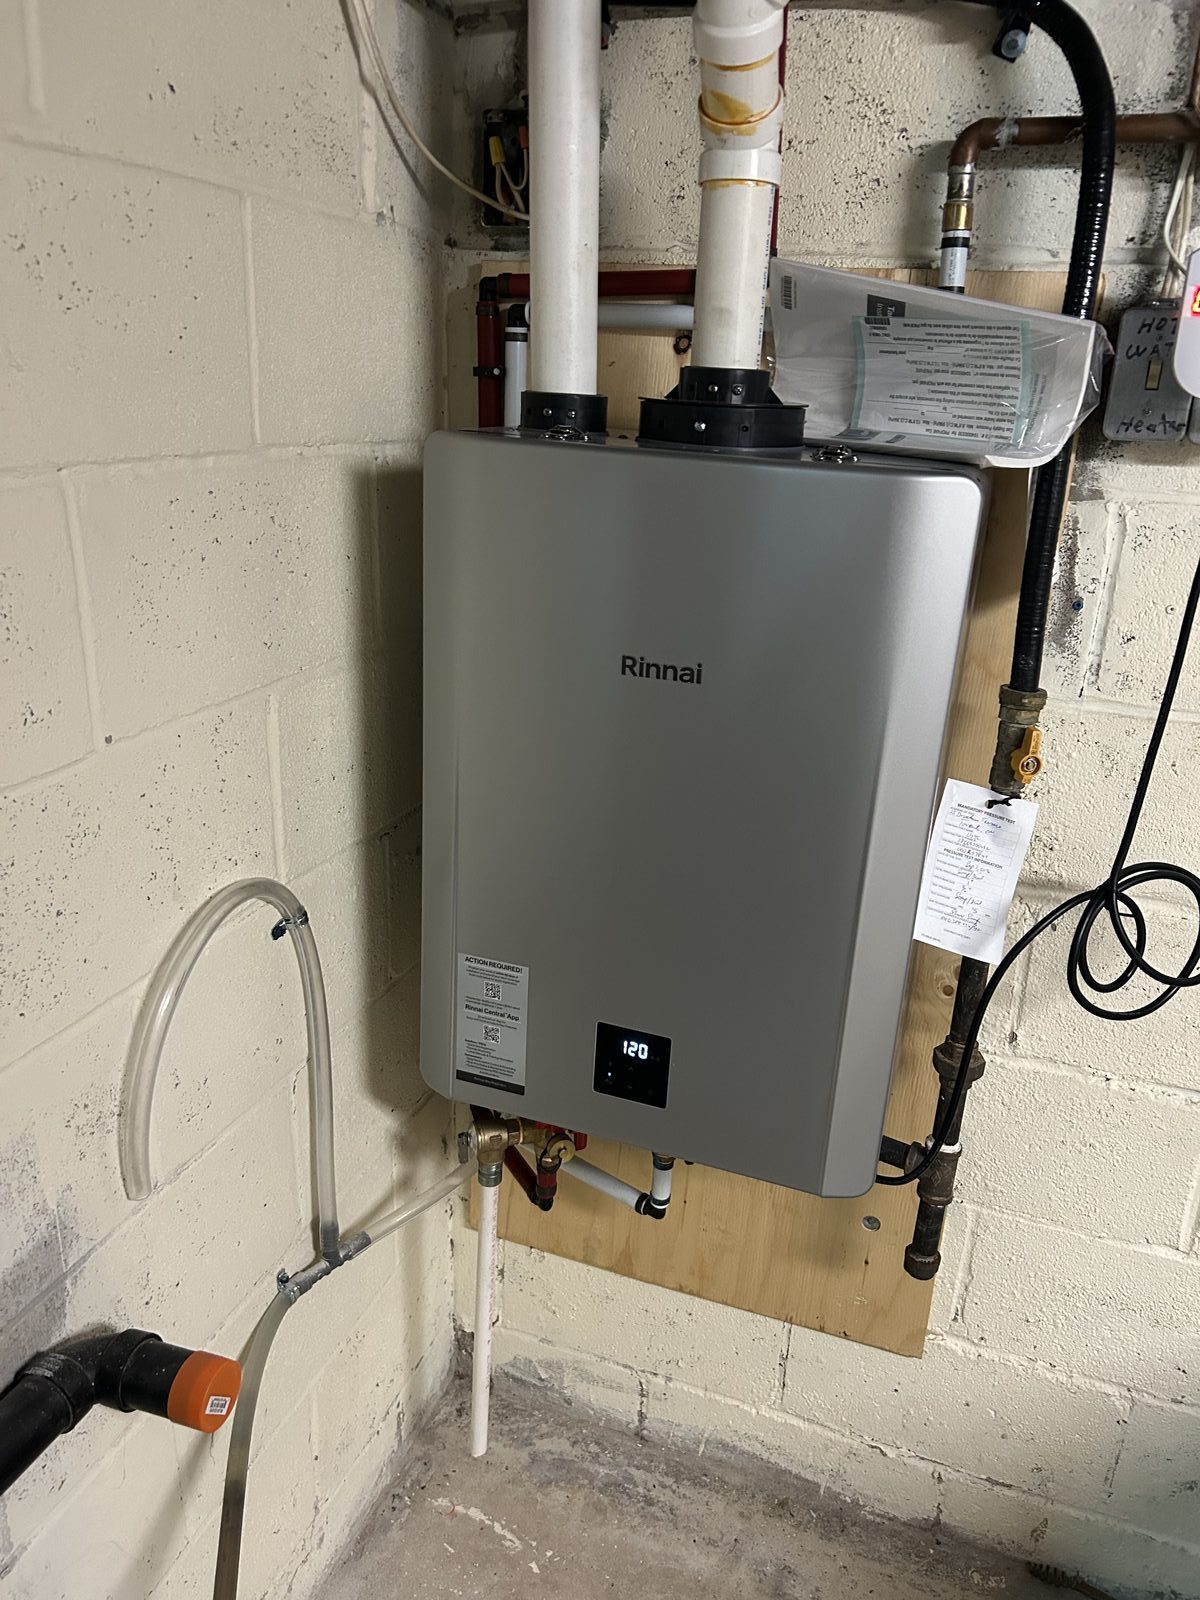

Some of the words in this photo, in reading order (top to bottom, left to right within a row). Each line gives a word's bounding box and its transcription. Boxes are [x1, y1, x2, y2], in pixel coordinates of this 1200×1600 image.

[1137, 316, 1178, 335] HOT
[620, 654, 702, 684] Rinnai
[958, 803, 984, 814] MANDATORY
[984, 811, 1006, 822] PRESSURE
[944, 848, 964, 858] PRESSURE
[464, 956, 488, 967] ACTION
[488, 961, 523, 974] REQUIRED!
[464, 1004, 484, 1013] Rinnai
[506, 1014, 520, 1022] App
[622, 1040, 649, 1060] 120
